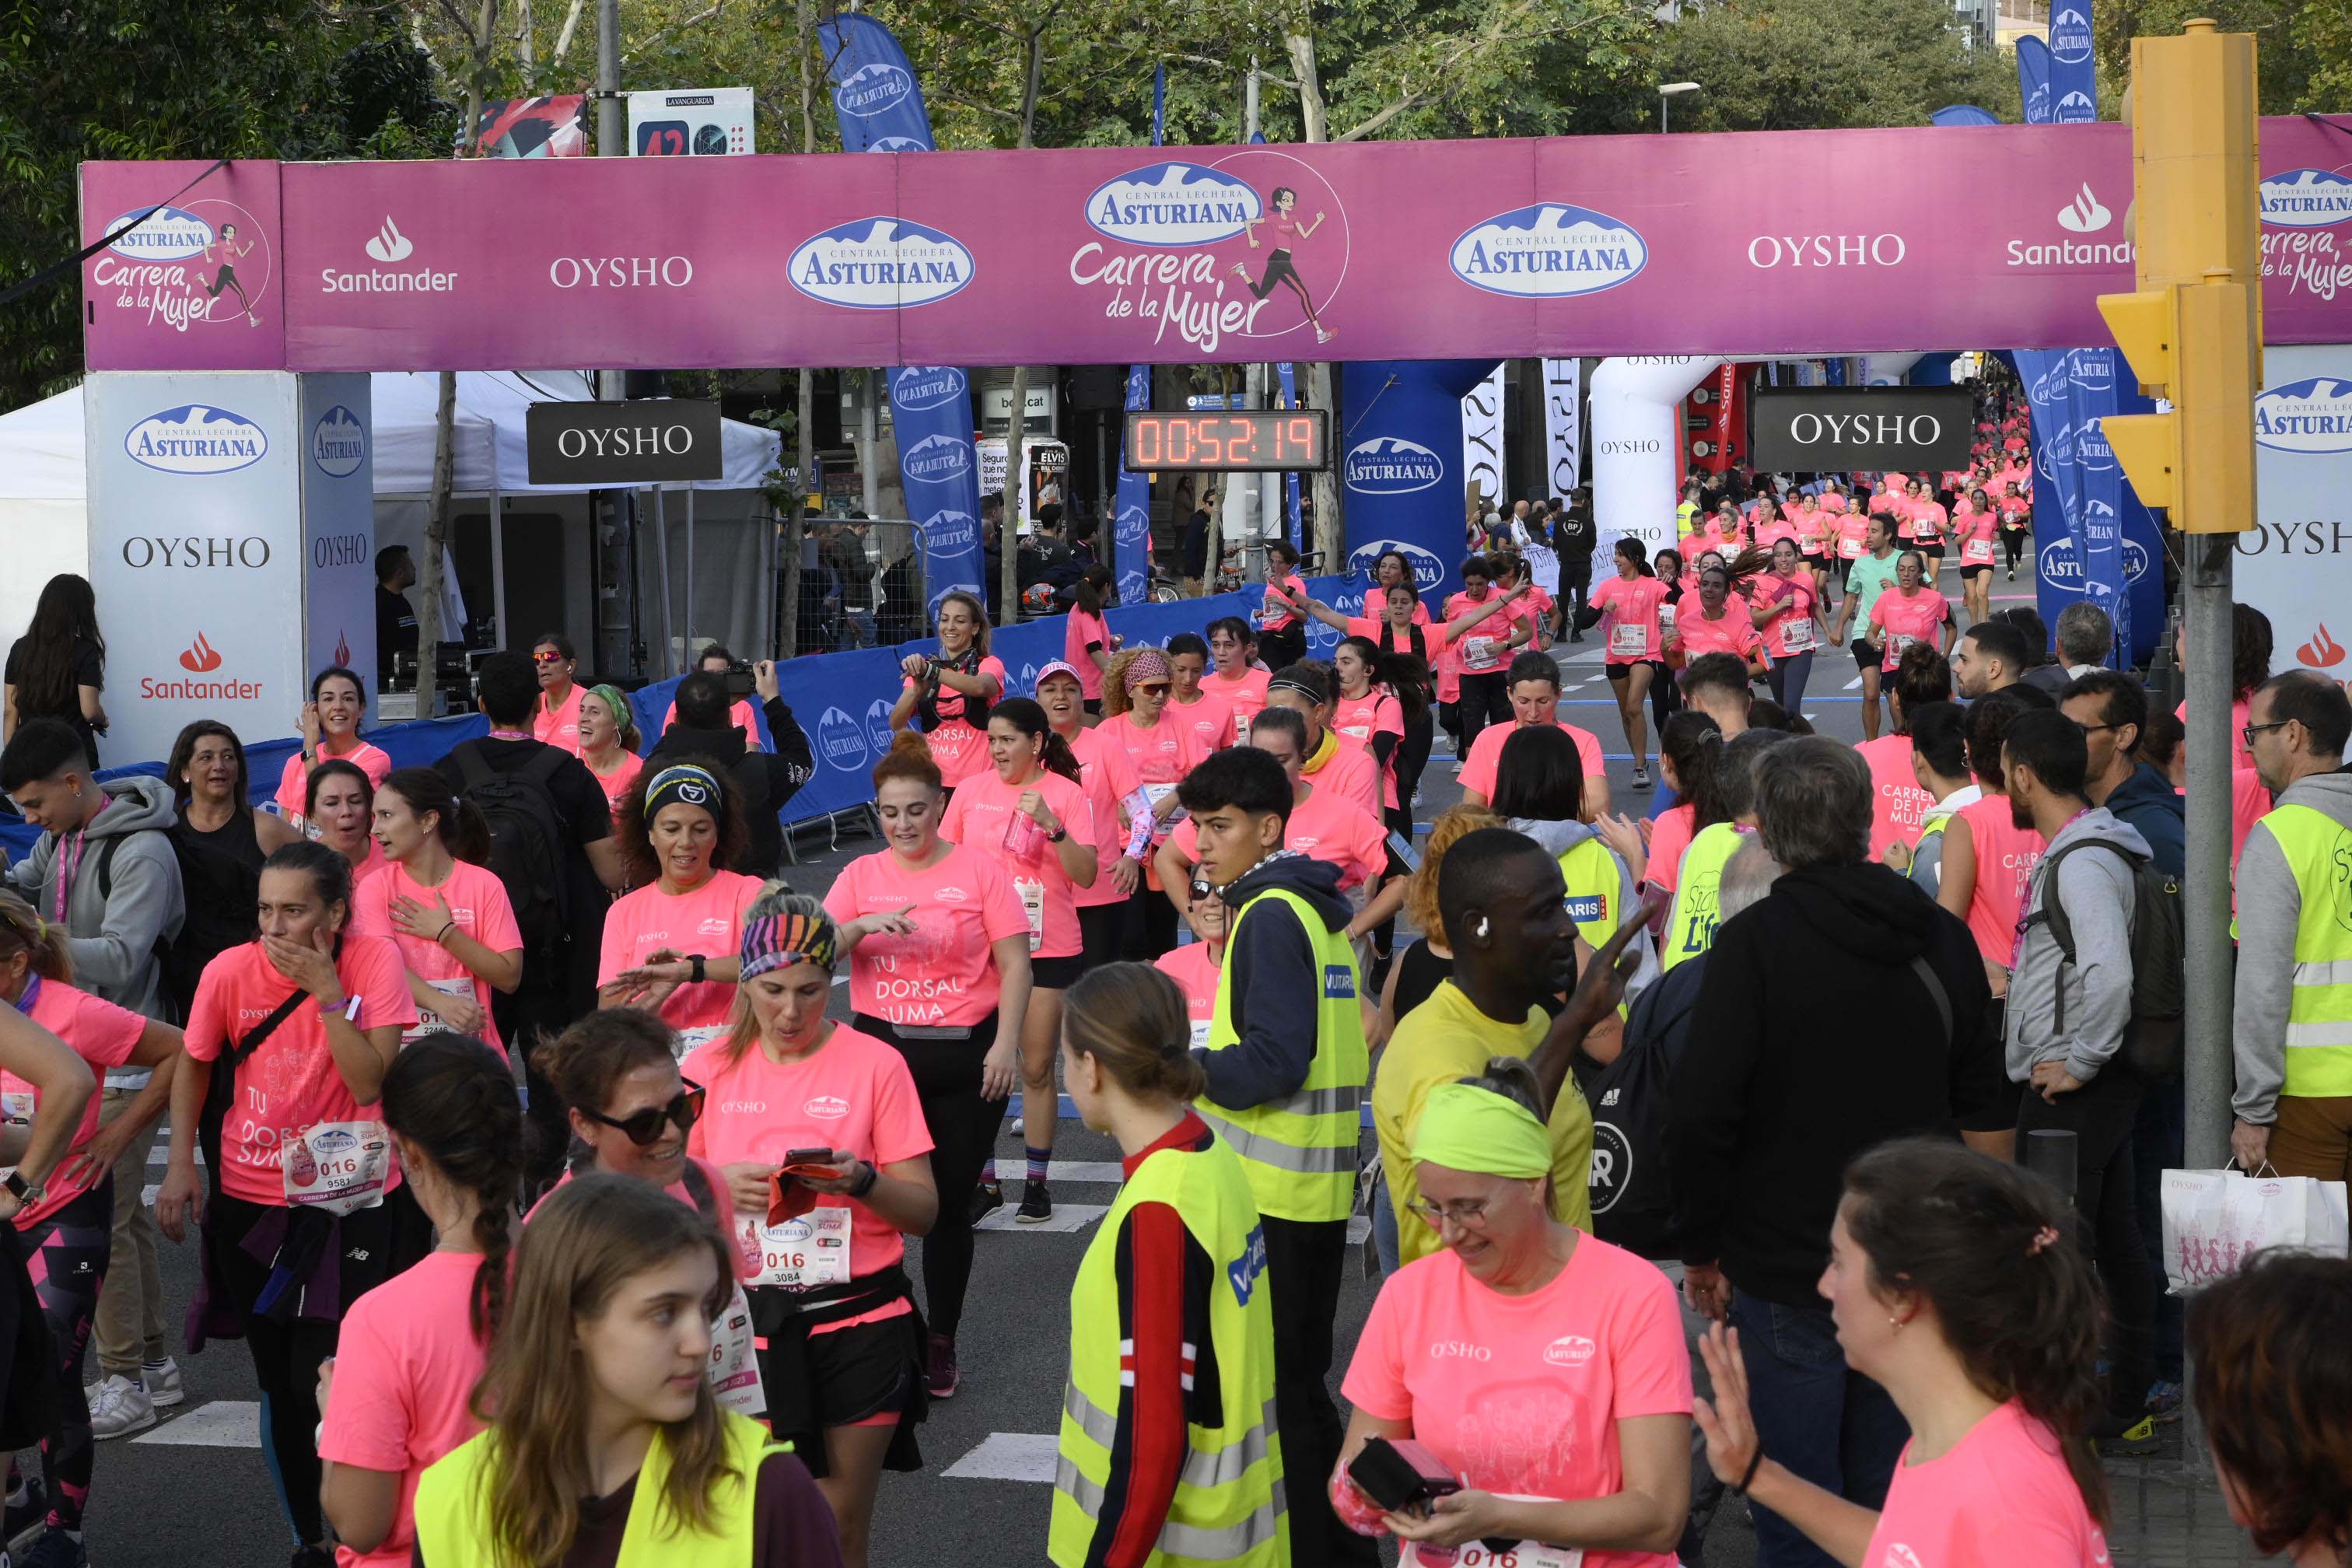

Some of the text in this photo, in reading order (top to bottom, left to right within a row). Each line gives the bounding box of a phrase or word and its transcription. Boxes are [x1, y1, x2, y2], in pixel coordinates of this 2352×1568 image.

[1125, 190, 1243, 200] CENTRAL LECHERA
[1097, 194, 1248, 226] ASTURIANA
[112, 226, 205, 247] ASTURIANA
[1495, 234, 1626, 246] CENTRAL LECHERA
[2260, 231, 2334, 254] arrera
[831, 248, 954, 257] CENTRAL LECHERA
[1464, 239, 1633, 274] ASTURIANA
[1748, 233, 1906, 268] OYSHO
[2007, 240, 2136, 265] Santand
[93, 257, 186, 287] Carrera
[549, 255, 693, 289] OYSHO
[802, 251, 960, 285] ASTURIANA
[1069, 242, 1216, 286] Carrera
[2279, 254, 2293, 276] la
[321, 268, 458, 292] Santander
[117, 283, 221, 332] de la Mujer
[1105, 279, 1270, 353] de la Mujer
[2277, 404, 2329, 412] CENTRAL
[1138, 419, 1313, 462] 00:52:19
[1790, 413, 1941, 446] OYSHO
[136, 431, 257, 457] ASTURIANA
[317, 433, 362, 461] ASTURIANA
[558, 425, 693, 459] OYSHO
[1601, 439, 1660, 456] OYSHO
[1041, 452, 1066, 463] ELVIS
[1348, 460, 1437, 482] ASTURIANA
[123, 537, 270, 569] OYSHO
[315, 533, 367, 569] OYSHO
[141, 677, 262, 699] Santander
[822, 733, 866, 758] ASTURIANA
[1894, 797, 1912, 811] DE
[1564, 902, 1599, 917] ARIS
[871, 955, 896, 975] TU
[876, 976, 964, 1001] DORSAL
[421, 1012, 439, 1024] 01
[880, 1002, 946, 1024] SUMA
[247, 1086, 268, 1115] TU
[721, 1101, 766, 1115] OYSHO
[807, 1104, 849, 1115] ASTURIANA
[317, 1139, 354, 1150] ASTURIANA
[320, 1158, 356, 1177] 016
[327, 1177, 351, 1188] 9581
[346, 1186, 363, 1195] MUJER
[2171, 1180, 2203, 1192] OYSHO
[765, 1228, 809, 1237] ASTURIANA
[766, 1252, 805, 1269] 016
[775, 1272, 801, 1283] 3084
[1430, 1339, 1492, 1363] OSHO
[1463, 1549, 1517, 1568] 016
